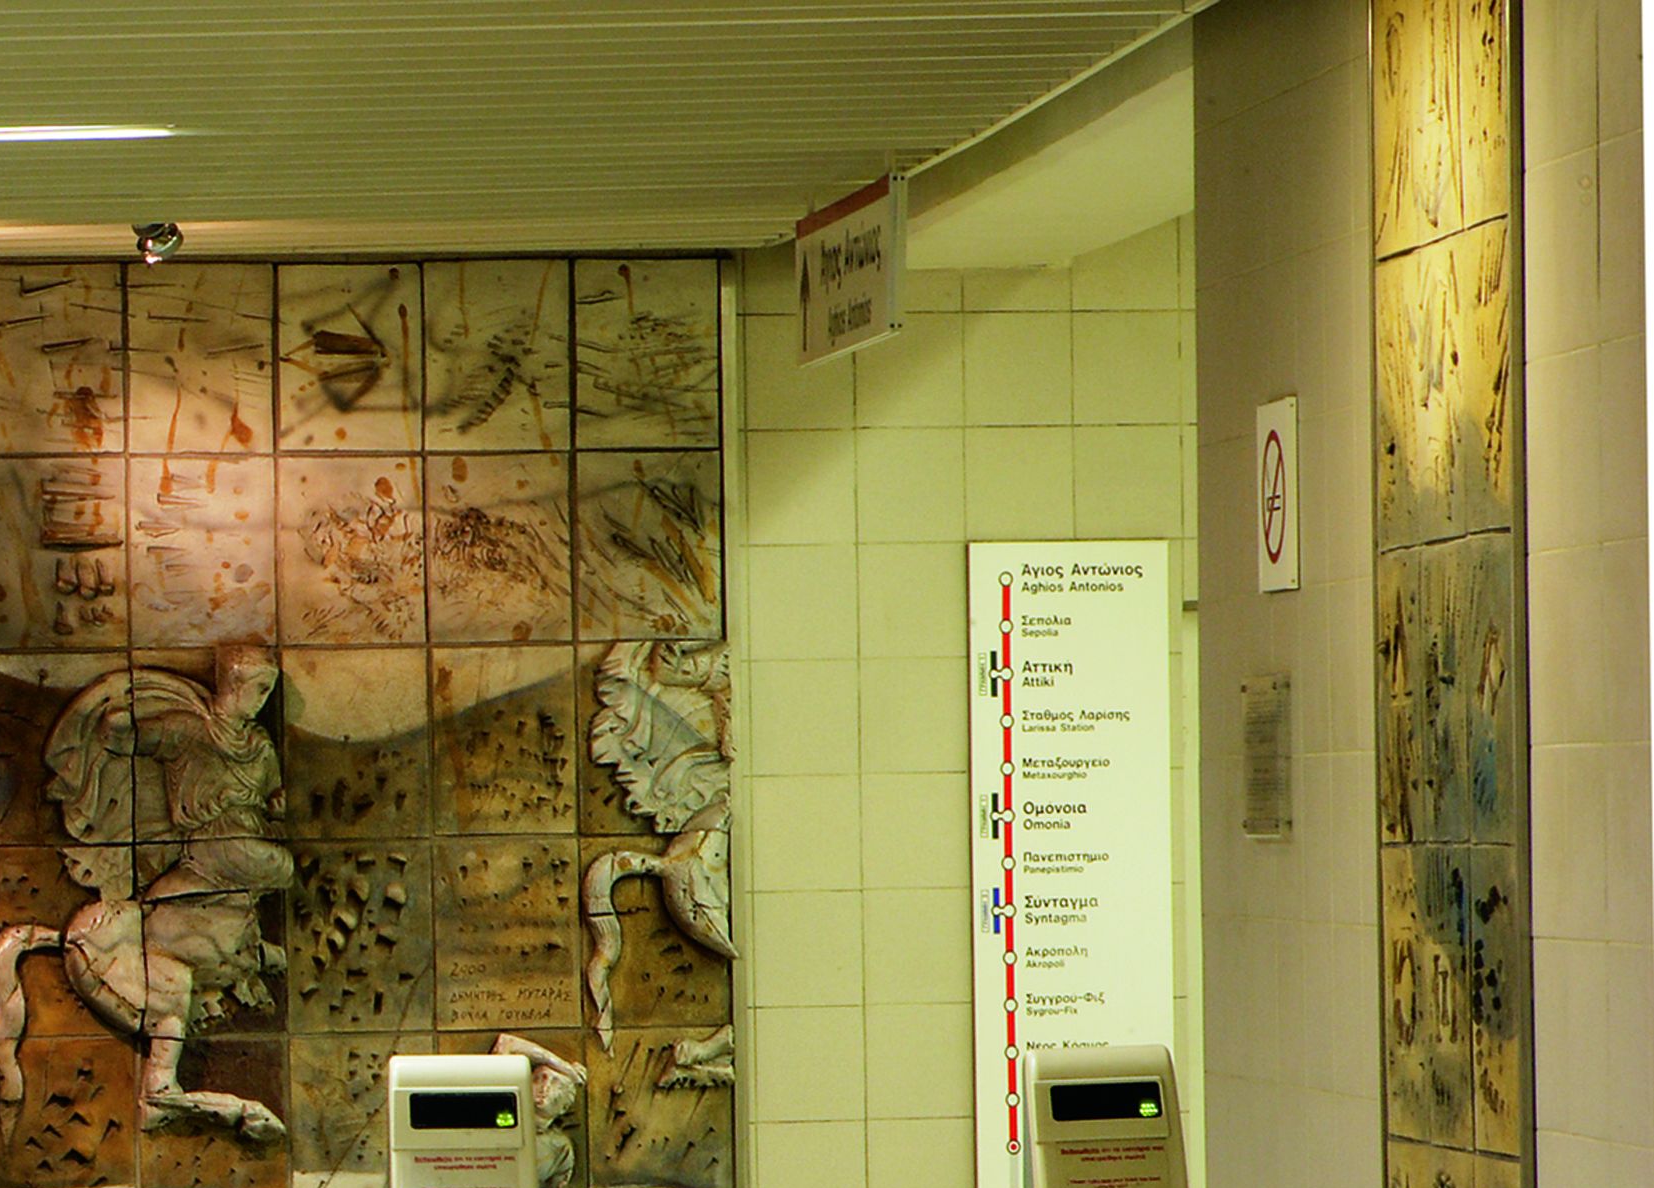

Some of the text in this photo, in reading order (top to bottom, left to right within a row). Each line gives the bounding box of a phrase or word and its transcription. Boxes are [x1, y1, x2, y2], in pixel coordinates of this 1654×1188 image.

[1071, 562, 1143, 578] Αντώνιος
[1021, 580, 1124, 595] Aghios Antonios
[1021, 628, 1059, 638] Sepolia
[1021, 676, 1055, 688] Attiki
[1021, 722, 1095, 733] Larissa Station
[1023, 818, 1071, 830] Omonia
[1023, 865, 1084, 875] Panepistimio
[1024, 912, 1087, 926] Syntagma
